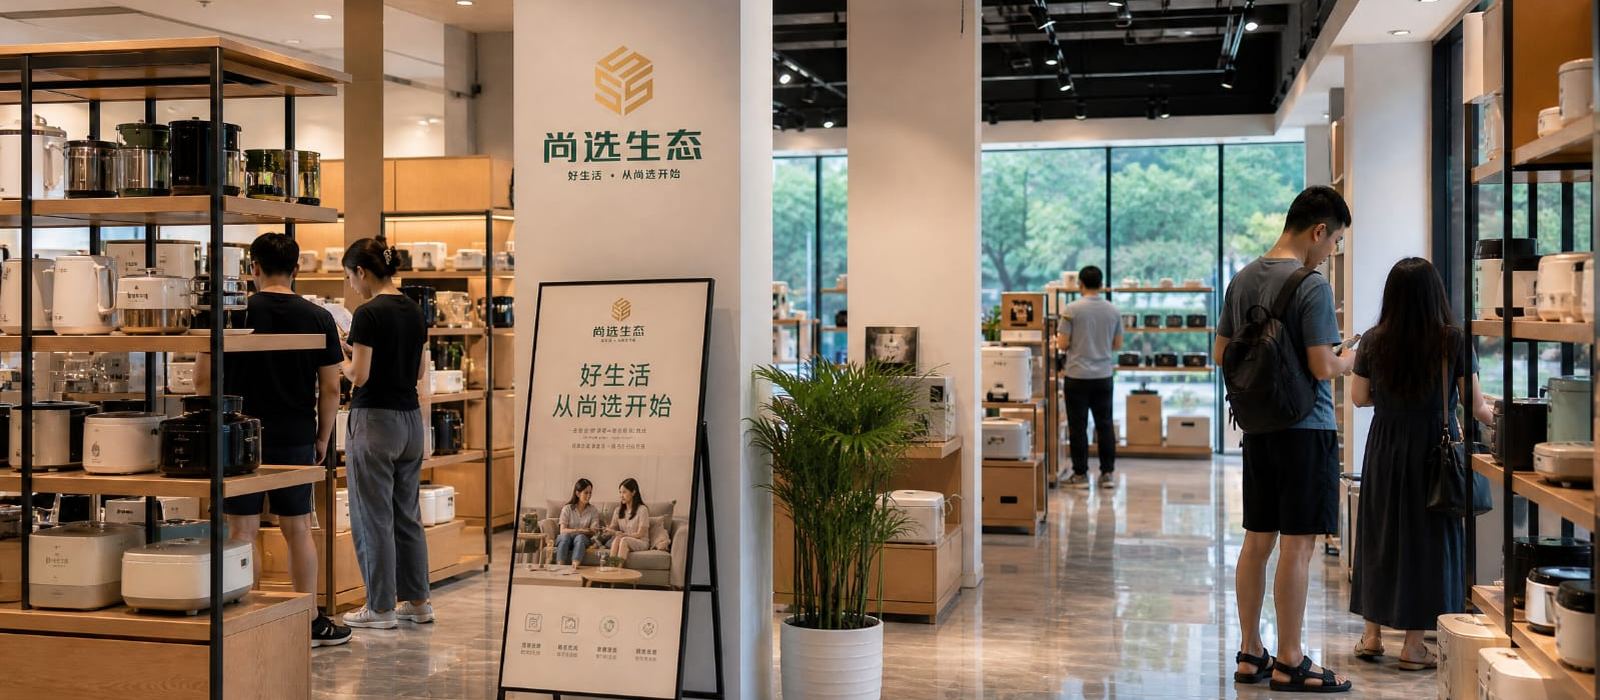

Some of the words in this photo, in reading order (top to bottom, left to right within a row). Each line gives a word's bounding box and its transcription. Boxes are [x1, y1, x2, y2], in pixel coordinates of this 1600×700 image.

[543, 128, 703, 163] 尚选生态
[567, 170, 602, 181] 好生活
[622, 168, 681, 180] 从尚选开始
[592, 325, 646, 338] 尚选生态
[579, 362, 651, 388] 好生活
[552, 393, 673, 418] 从尚选开始
